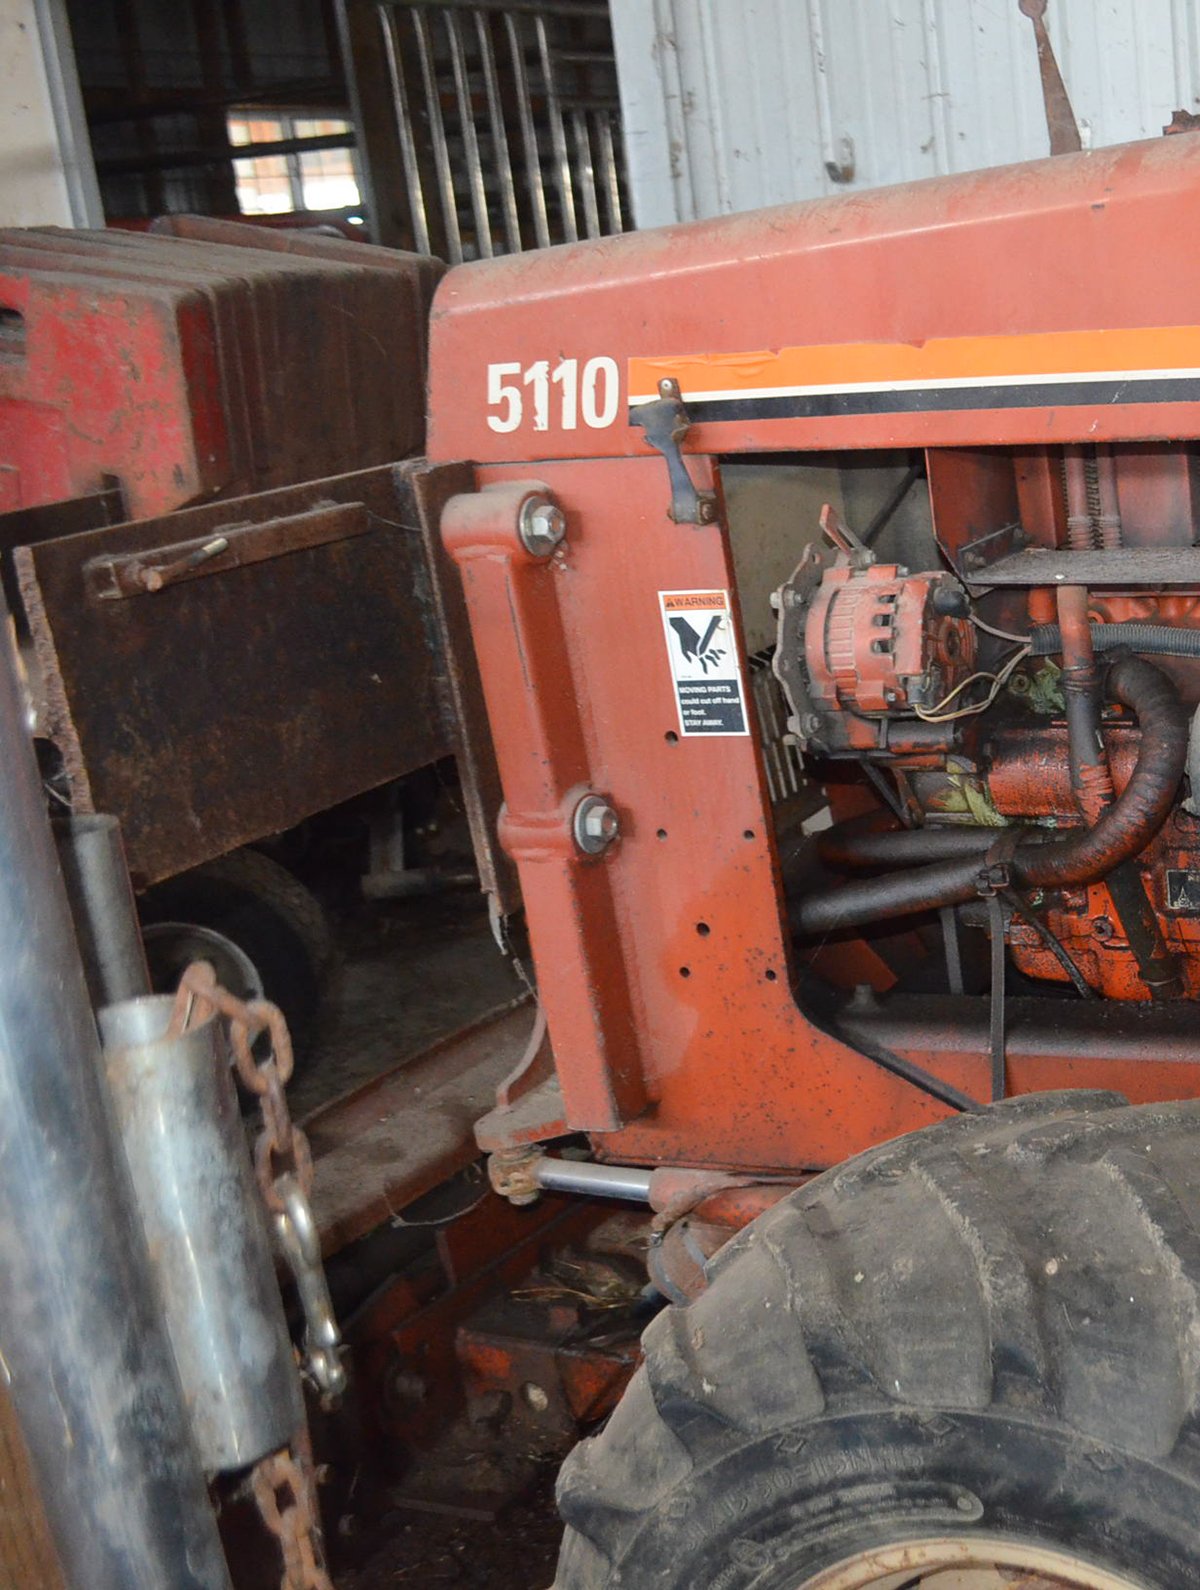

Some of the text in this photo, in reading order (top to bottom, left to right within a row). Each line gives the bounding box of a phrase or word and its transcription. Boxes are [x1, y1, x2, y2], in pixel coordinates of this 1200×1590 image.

[487, 356, 619, 433] 5110
[674, 596, 724, 606] WARNING
[679, 685, 731, 694] MOVING PARTS
[681, 697, 699, 705] could
[685, 719, 701, 727] STAY
